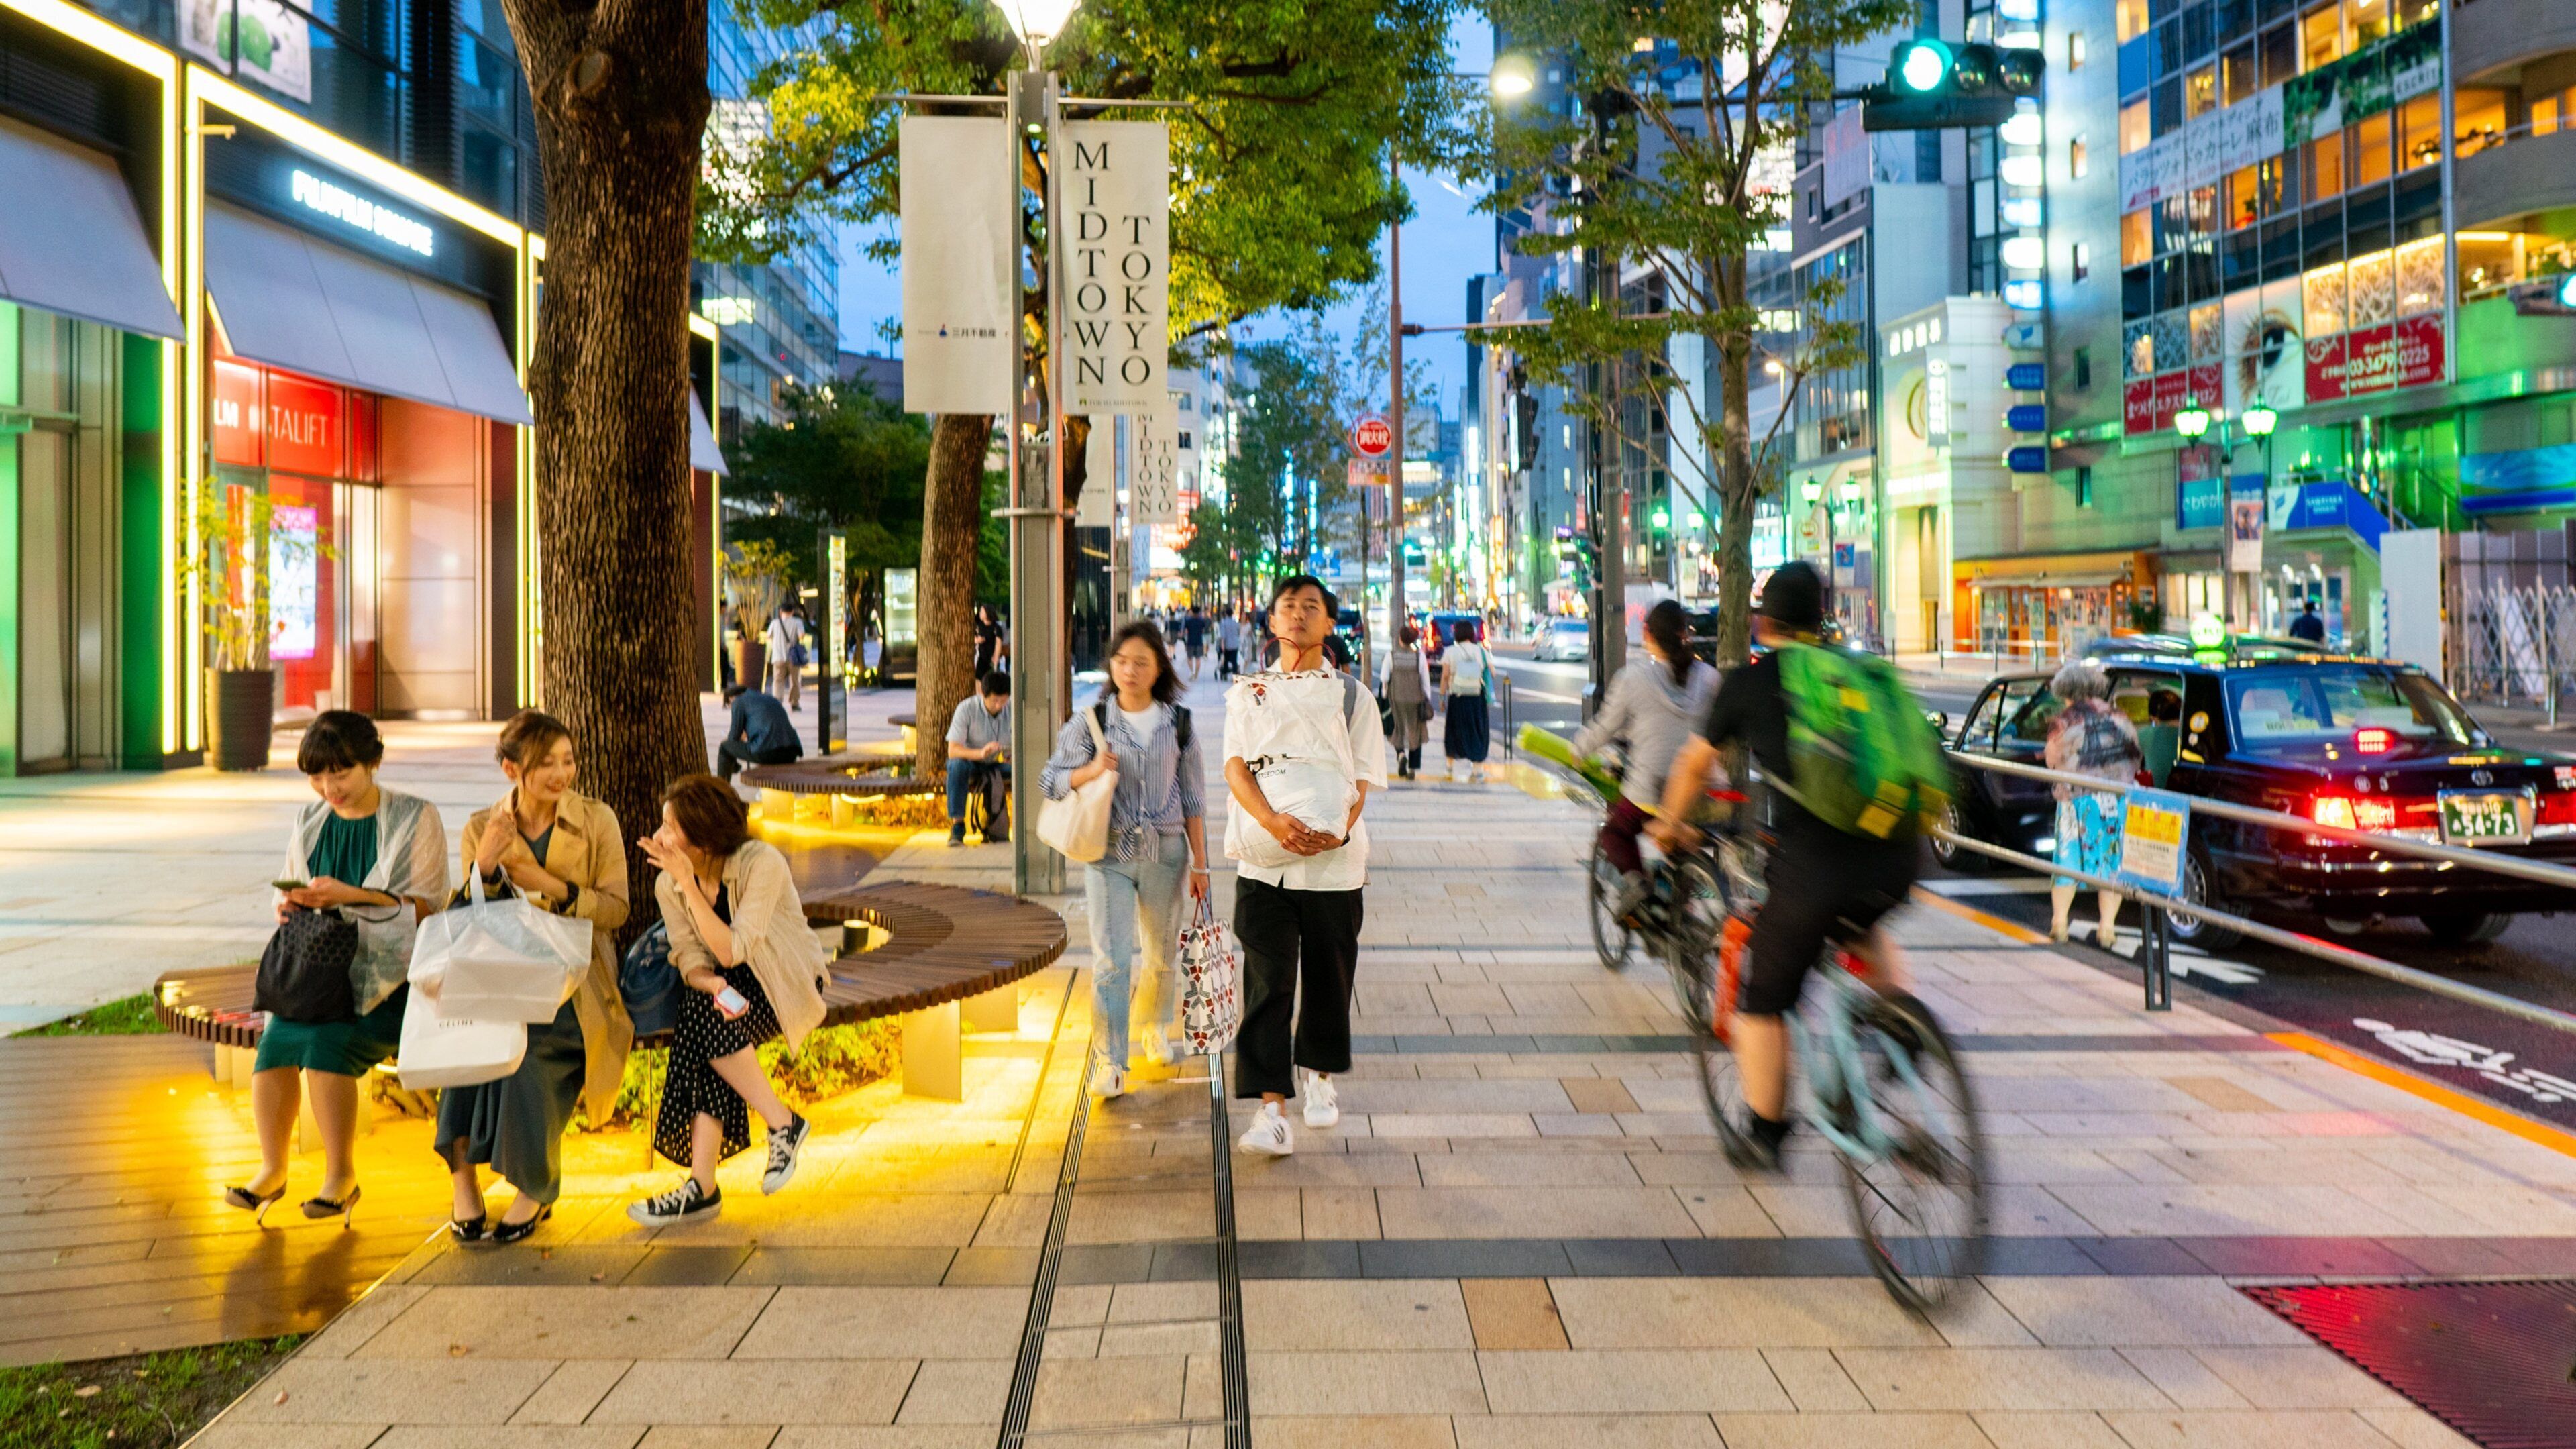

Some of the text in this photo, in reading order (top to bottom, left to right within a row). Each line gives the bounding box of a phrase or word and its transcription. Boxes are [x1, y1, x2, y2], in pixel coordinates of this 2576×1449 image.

[1071, 140, 1152, 386] MIDTOWN TOKYO
[1159, 440, 1171, 514] TOKYO
